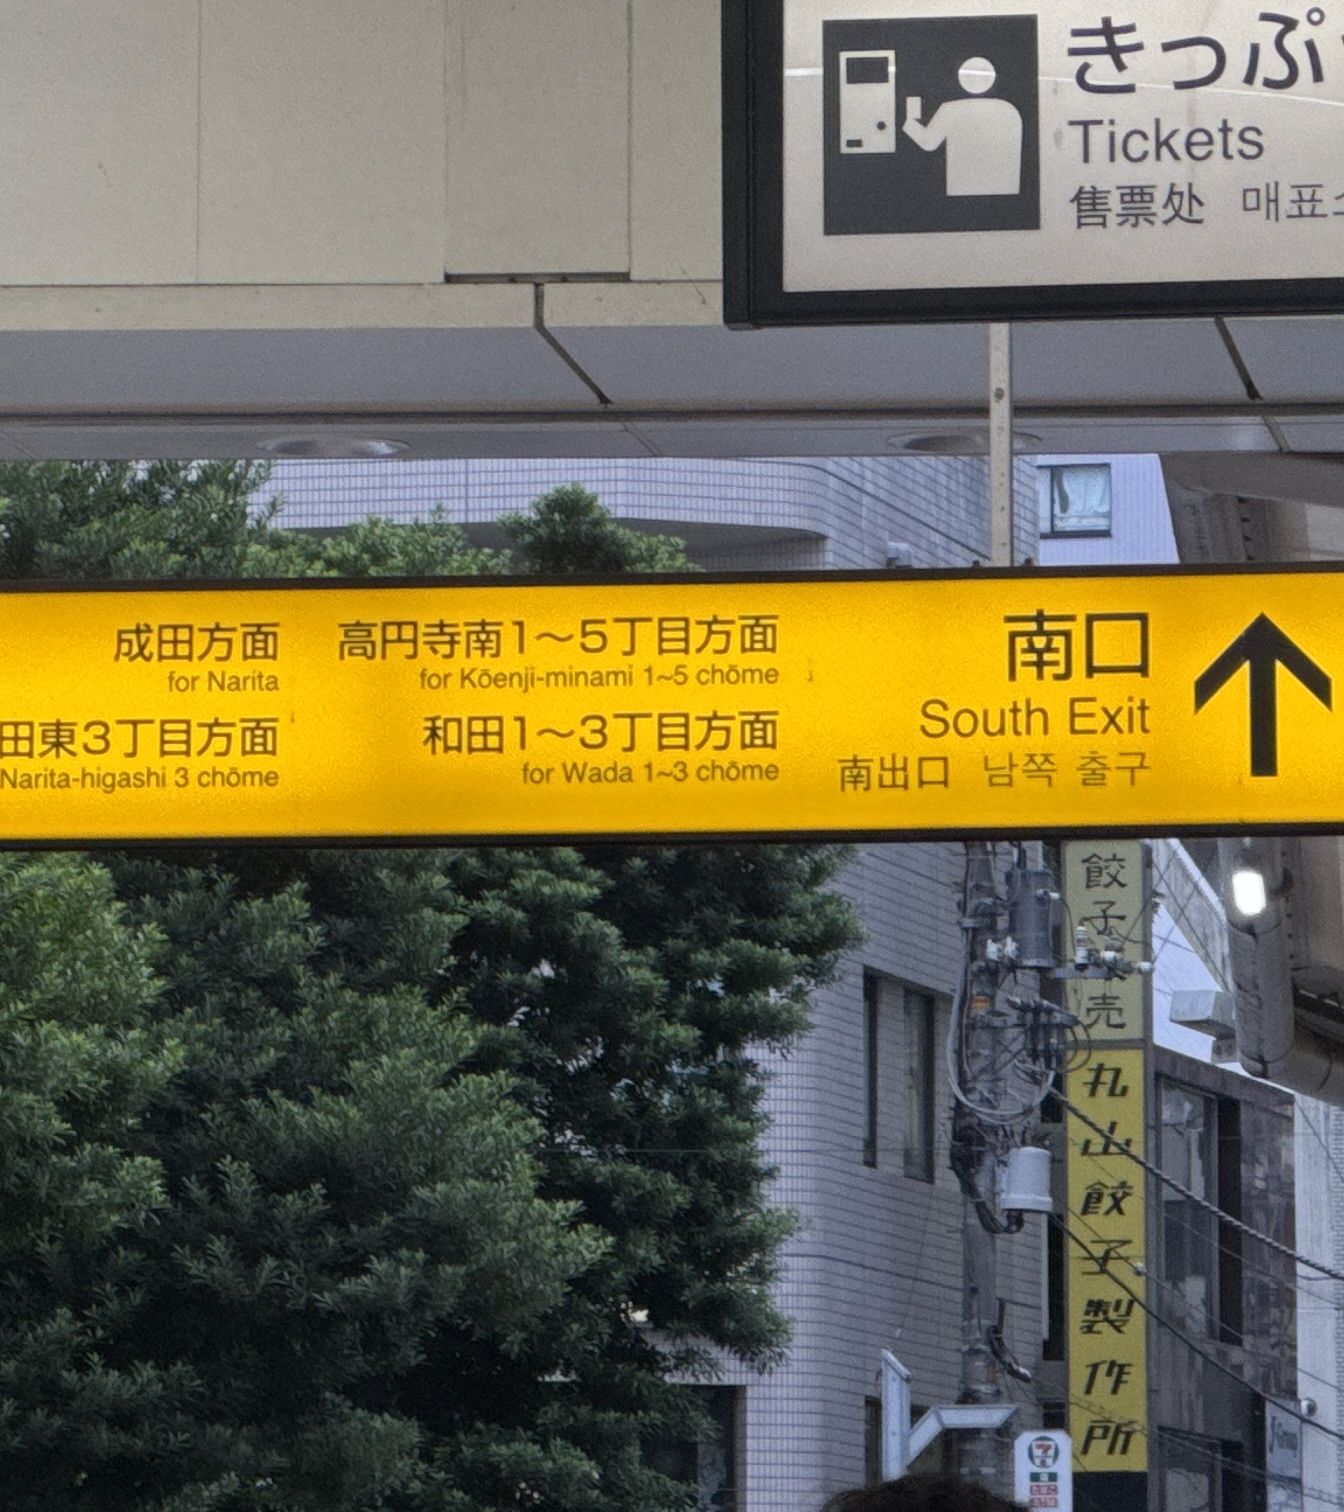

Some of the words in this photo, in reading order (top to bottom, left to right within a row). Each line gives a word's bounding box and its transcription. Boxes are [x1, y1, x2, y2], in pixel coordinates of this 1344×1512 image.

[1068, 118, 1264, 164] Tickets
[1070, 182, 1204, 229] 售票处
[115, 622, 279, 662] 成田方面
[1004, 609, 1149, 681] 南口
[168, 671, 199, 692] for
[208, 671, 279, 691] Narita
[419, 668, 452, 690] for
[460, 665, 633, 693] Kōenji-minami
[695, 664, 779, 685] chōme
[920, 698, 1048, 738] South
[1069, 696, 1150, 735] Exit
[0, 767, 166, 794] Narita-higashi
[175, 767, 189, 788] 3
[197, 767, 279, 788] chōme
[522, 761, 554, 785] for
[562, 761, 633, 783] Wada
[695, 760, 779, 782] chōme
[838, 753, 949, 792] 南出口
[983, 752, 1057, 788] 남쪽
[1076, 750, 1150, 787] 출구
[1081, 853, 1127, 1029] 餃子売
[1080, 1062, 1135, 1456] 丸山餃子製作所
